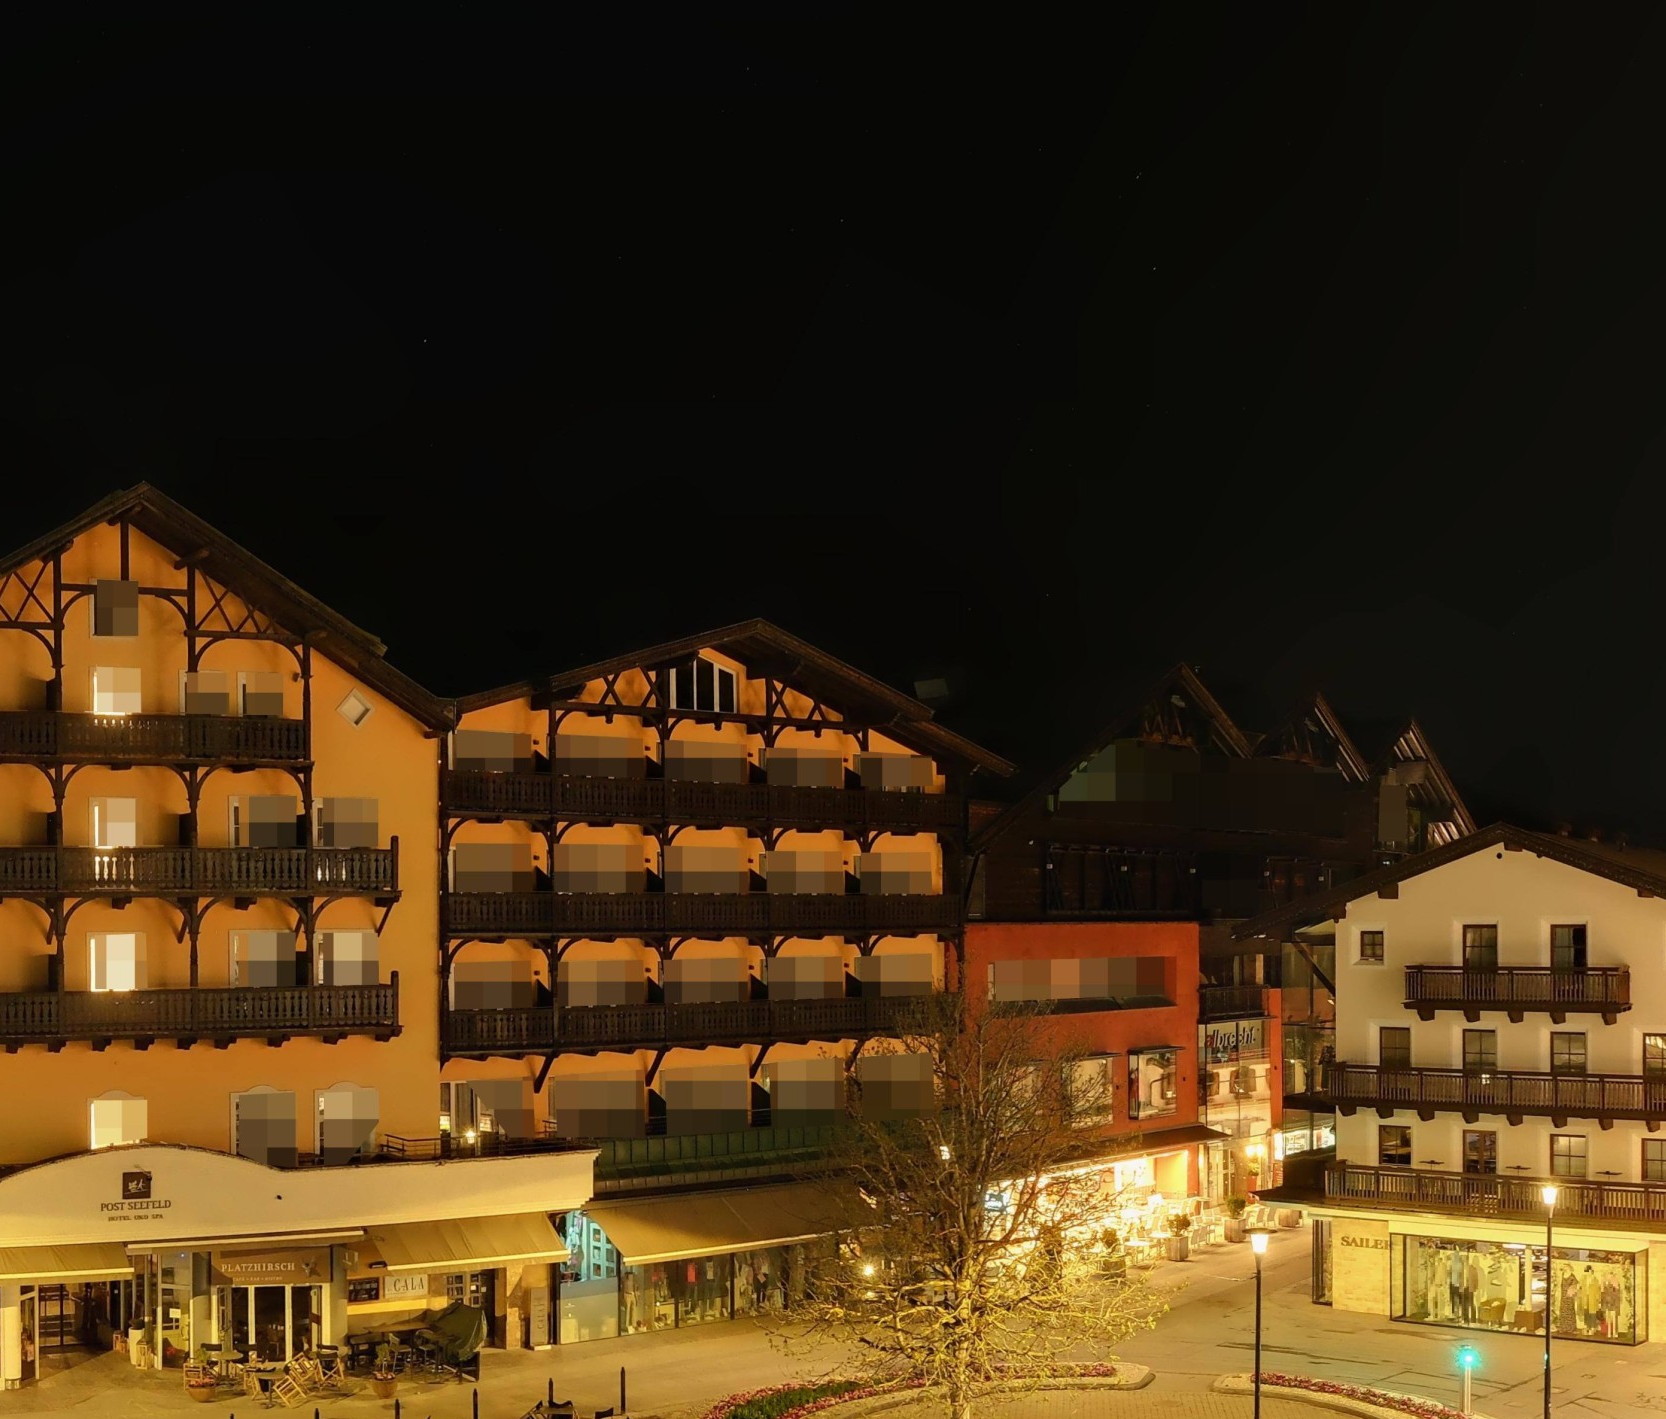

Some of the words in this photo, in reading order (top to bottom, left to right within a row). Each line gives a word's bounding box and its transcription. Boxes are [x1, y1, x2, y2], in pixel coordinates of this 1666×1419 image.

[100, 1202, 125, 1212] POST
[127, 1200, 172, 1210] SEEFELD
[221, 1262, 295, 1272] PLATZHIRSCH
